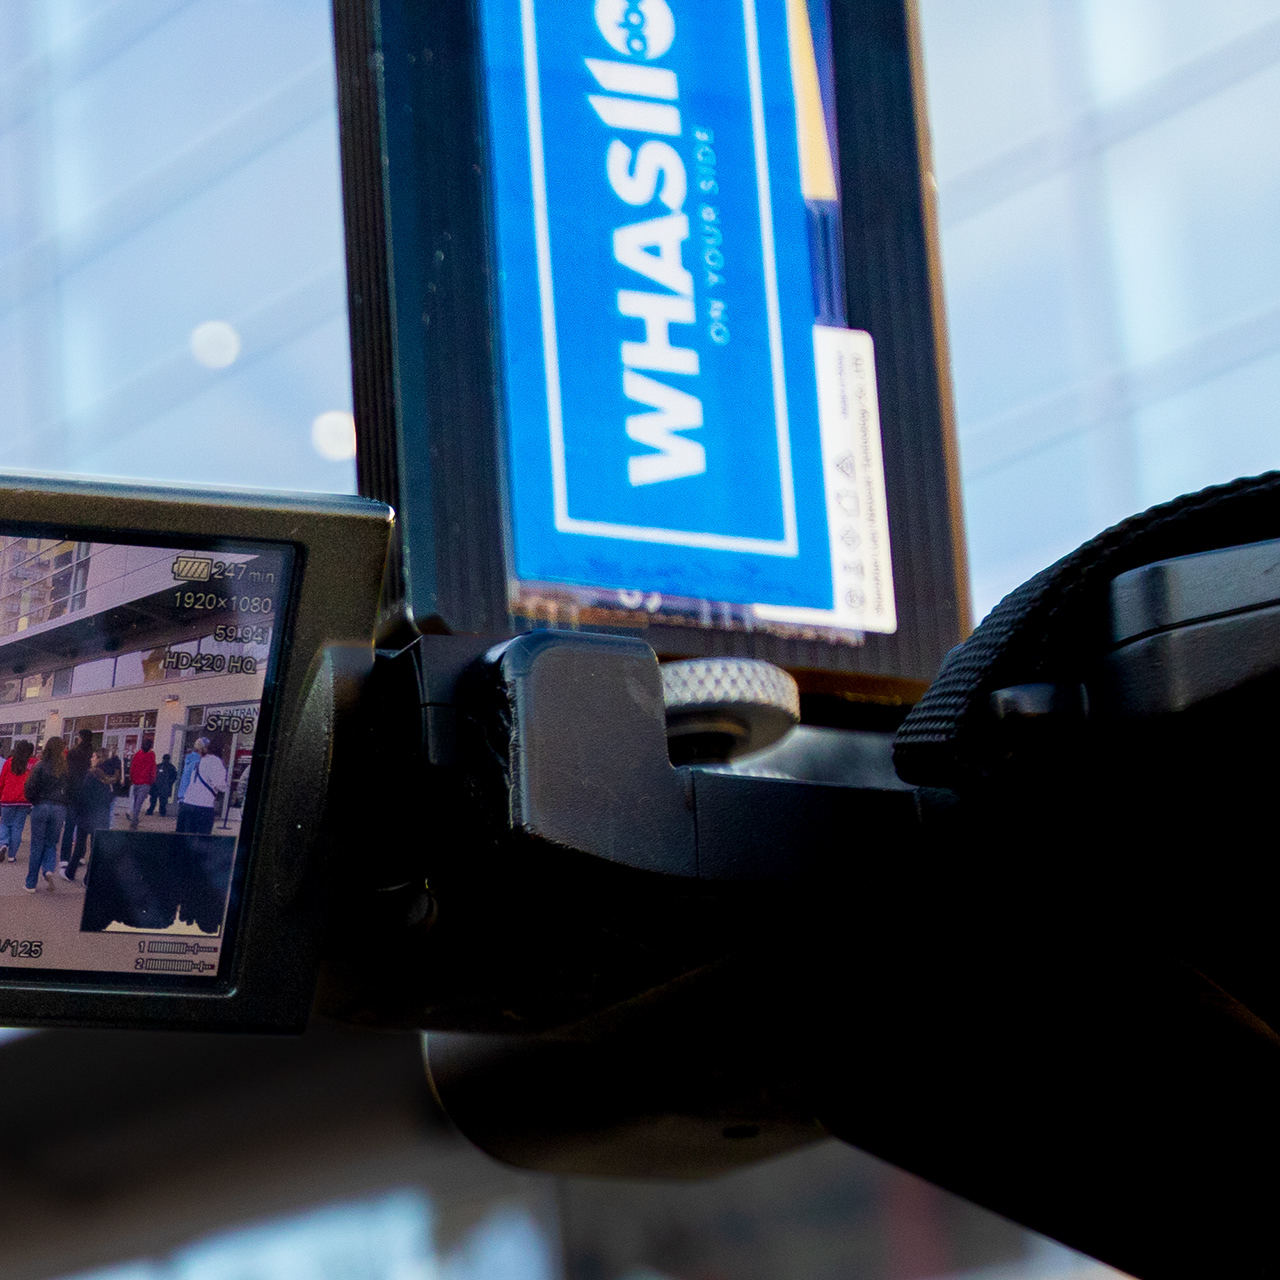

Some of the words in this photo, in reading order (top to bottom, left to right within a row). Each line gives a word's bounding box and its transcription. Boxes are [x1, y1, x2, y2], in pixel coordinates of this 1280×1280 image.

[692, 126, 716, 197] SIDE
[583, 55, 707, 489] WHAS11
[700, 205, 725, 292] YOUR
[710, 297, 731, 346] ON
[212, 562, 247, 580] 247
[248, 567, 276, 584] min
[164, 651, 225, 673] HD420
[228, 655, 257, 676] HQ
[206, 715, 255, 734] STD5
